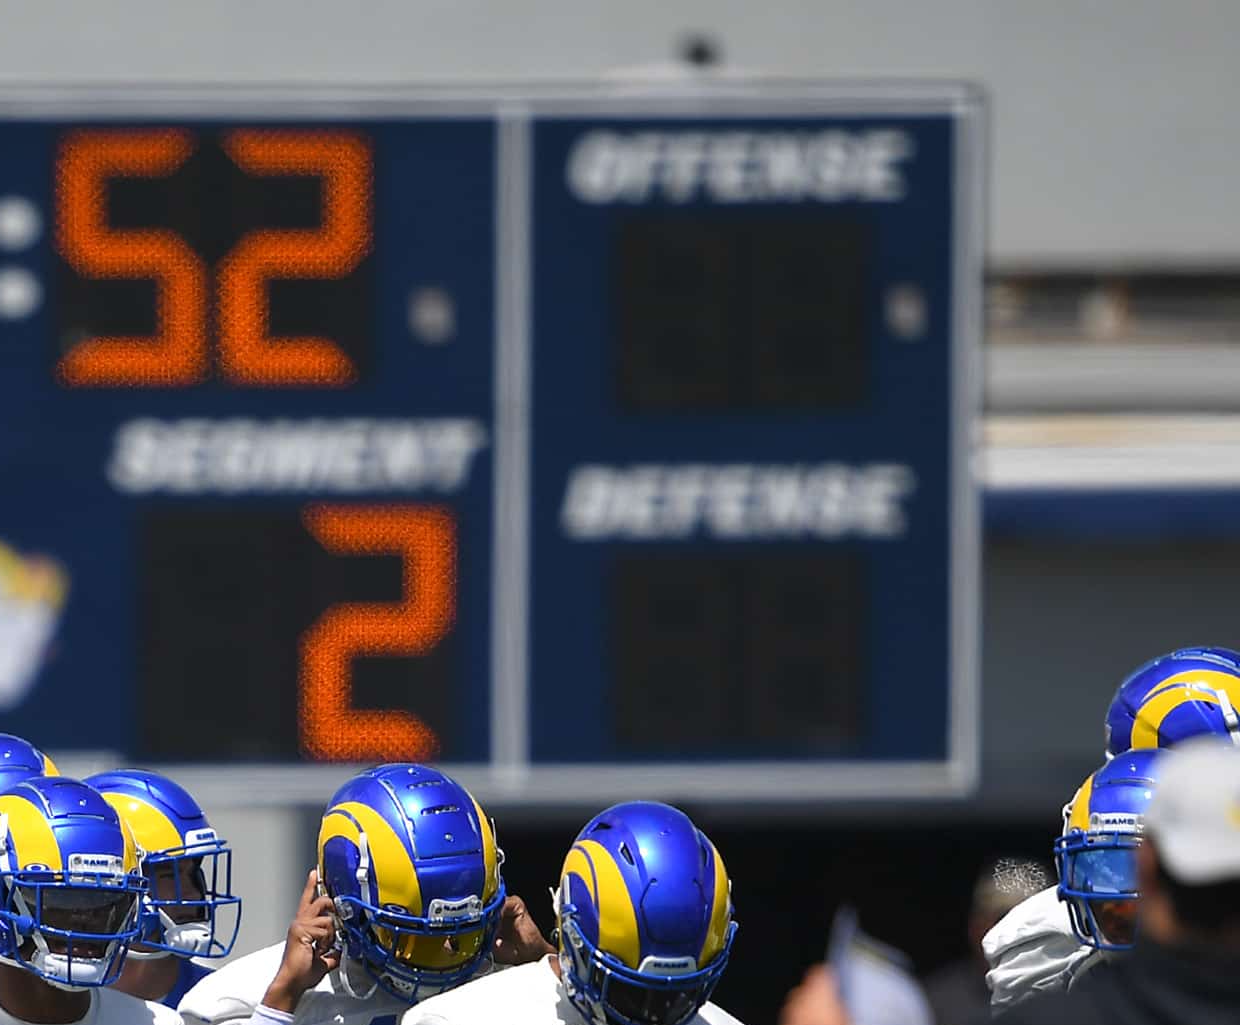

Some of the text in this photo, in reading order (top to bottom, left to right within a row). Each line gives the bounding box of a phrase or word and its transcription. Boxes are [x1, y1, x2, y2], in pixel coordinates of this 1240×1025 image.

[566, 130, 914, 204] OFFENSE
[108, 418, 485, 494] SEGMENT
[563, 463, 914, 541] DEFENSE
[300, 504, 458, 762] 2
[1104, 817, 1135, 825] RAMS
